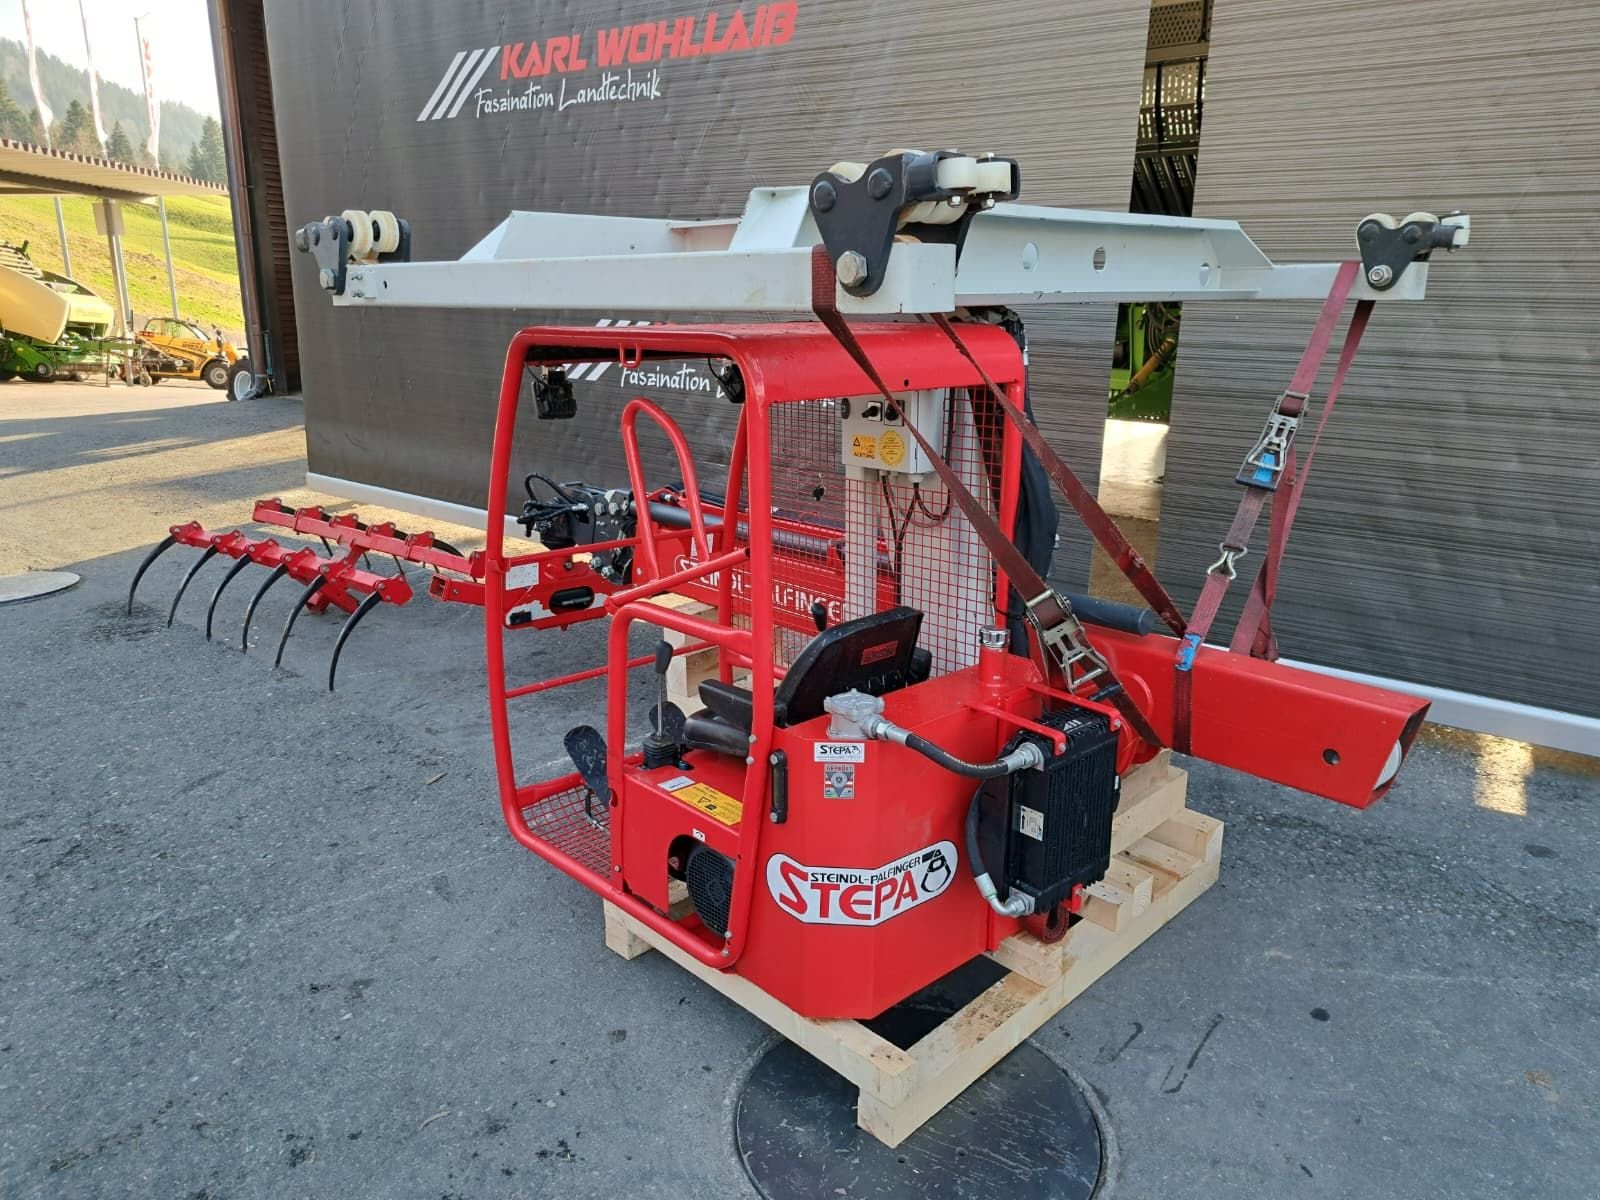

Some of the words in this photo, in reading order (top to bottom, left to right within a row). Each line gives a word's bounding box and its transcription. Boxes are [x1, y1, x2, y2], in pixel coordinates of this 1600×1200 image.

[500, 34, 587, 80] KARL
[598, 1, 798, 67] WOHLLAIB
[475, 81, 553, 118] Faszination
[559, 68, 661, 111] Landtechnik
[620, 363, 710, 391] Faszination
[820, 745, 851, 754] STEPA
[811, 856, 921, 884] STEINDL-PALFINGER
[779, 861, 918, 920] STEPA
